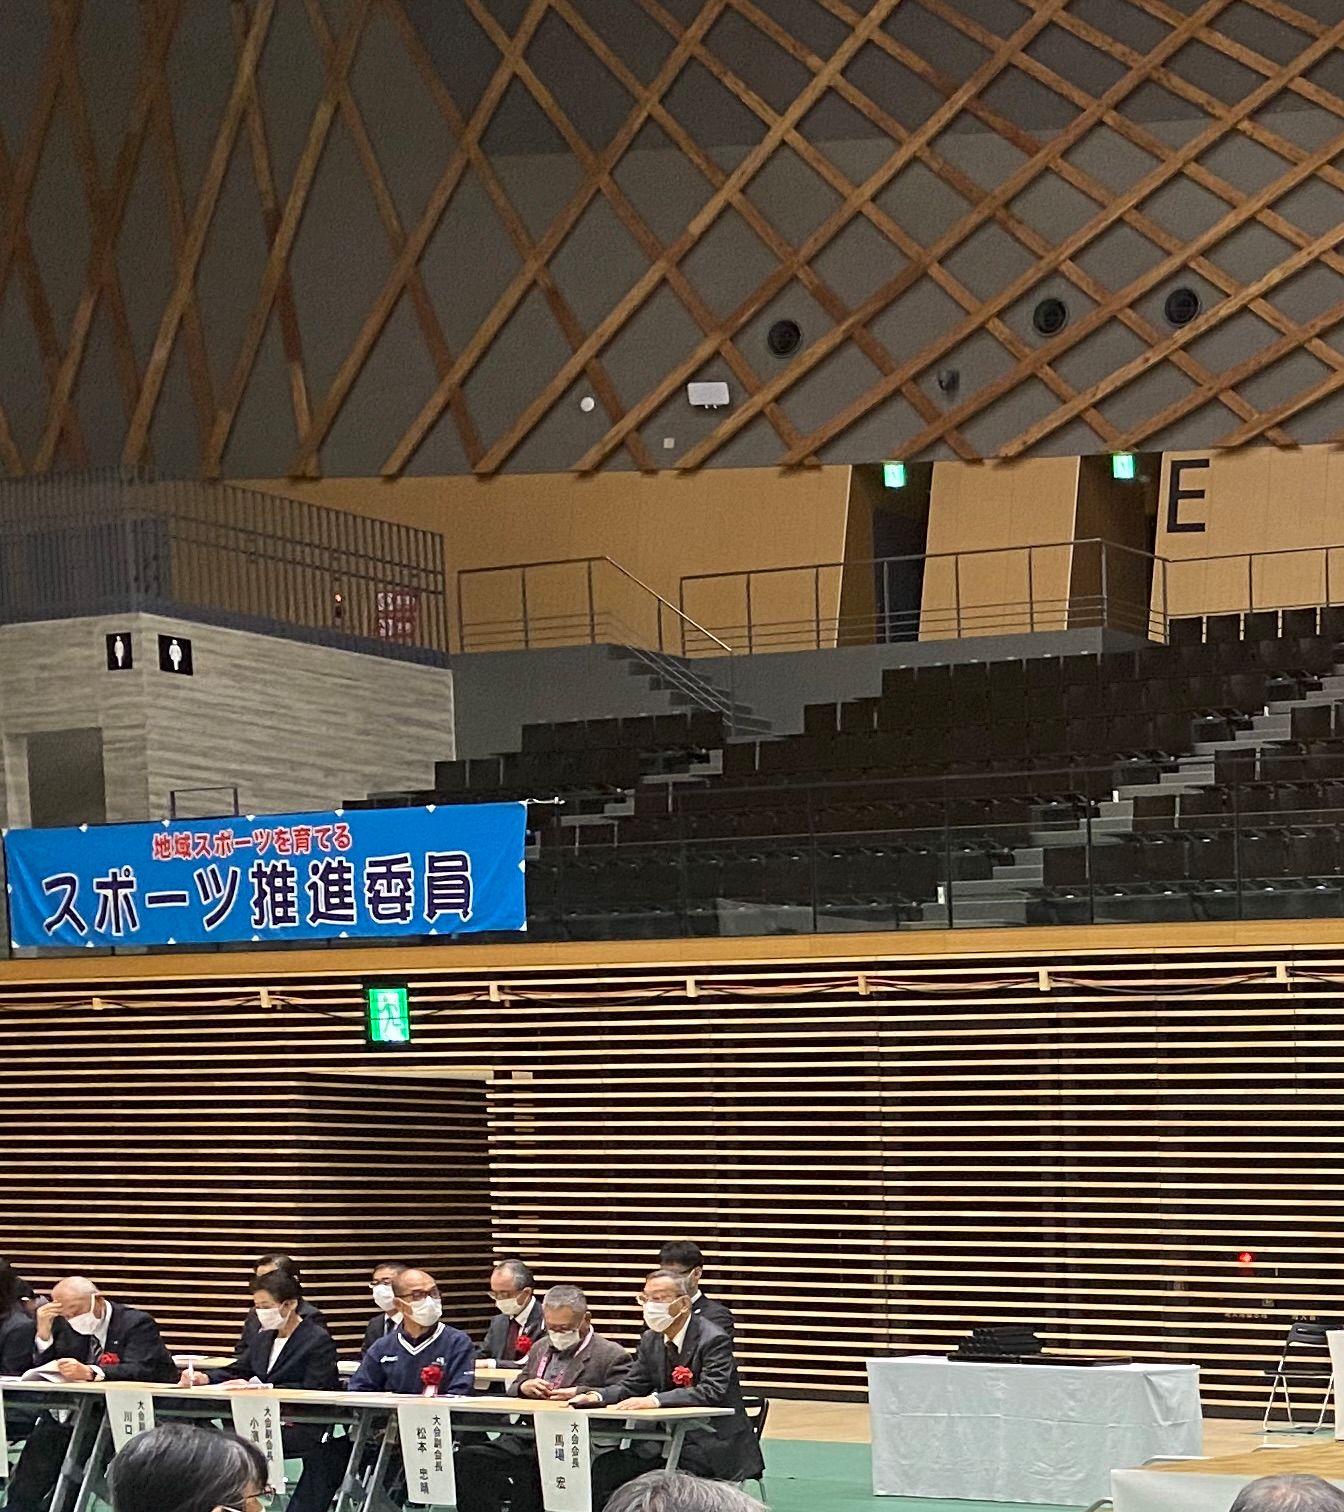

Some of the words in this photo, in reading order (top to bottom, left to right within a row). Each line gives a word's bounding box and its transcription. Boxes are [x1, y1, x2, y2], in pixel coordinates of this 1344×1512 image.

[1166, 458, 1210, 533] E
[152, 824, 352, 859] 地域スポーツを育てる
[42, 851, 474, 936] スポーツ推進委員
[416, 1427, 427, 1453] 松本
